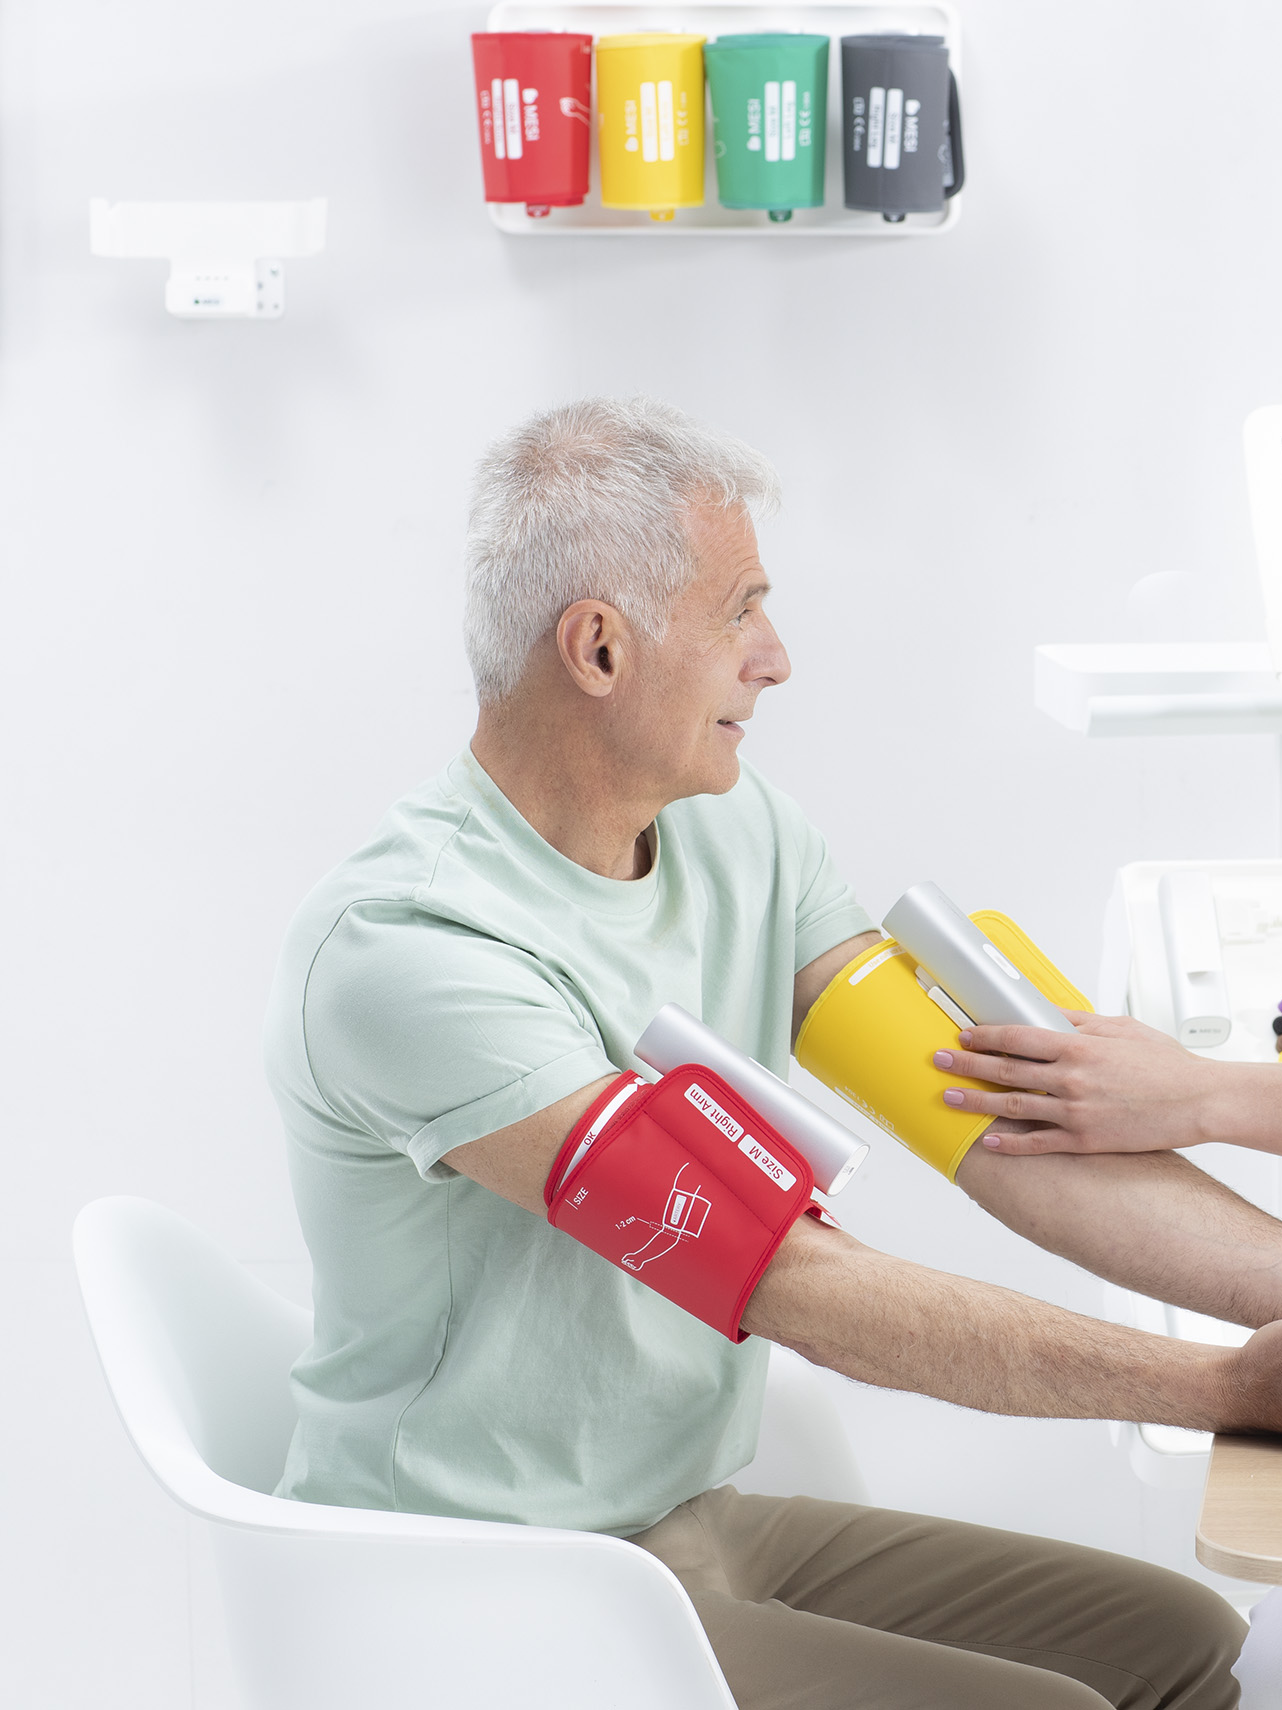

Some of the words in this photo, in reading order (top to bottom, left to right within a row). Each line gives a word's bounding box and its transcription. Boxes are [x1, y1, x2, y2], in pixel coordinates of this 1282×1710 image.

[523, 104, 540, 142] MESI
[625, 100, 637, 136] MESI
[747, 98, 761, 135] MESI
[904, 116, 919, 153] MESI
[689, 1088, 710, 1110] Arm
[710, 1109, 738, 1138] Right
[583, 1131, 597, 1146] OK
[748, 1145, 762, 1159] M
[761, 1157, 784, 1180] Size
[573, 1186, 589, 1206] SIZE
[614, 1219, 627, 1231] 1-2
[626, 1215, 637, 1225] cm
